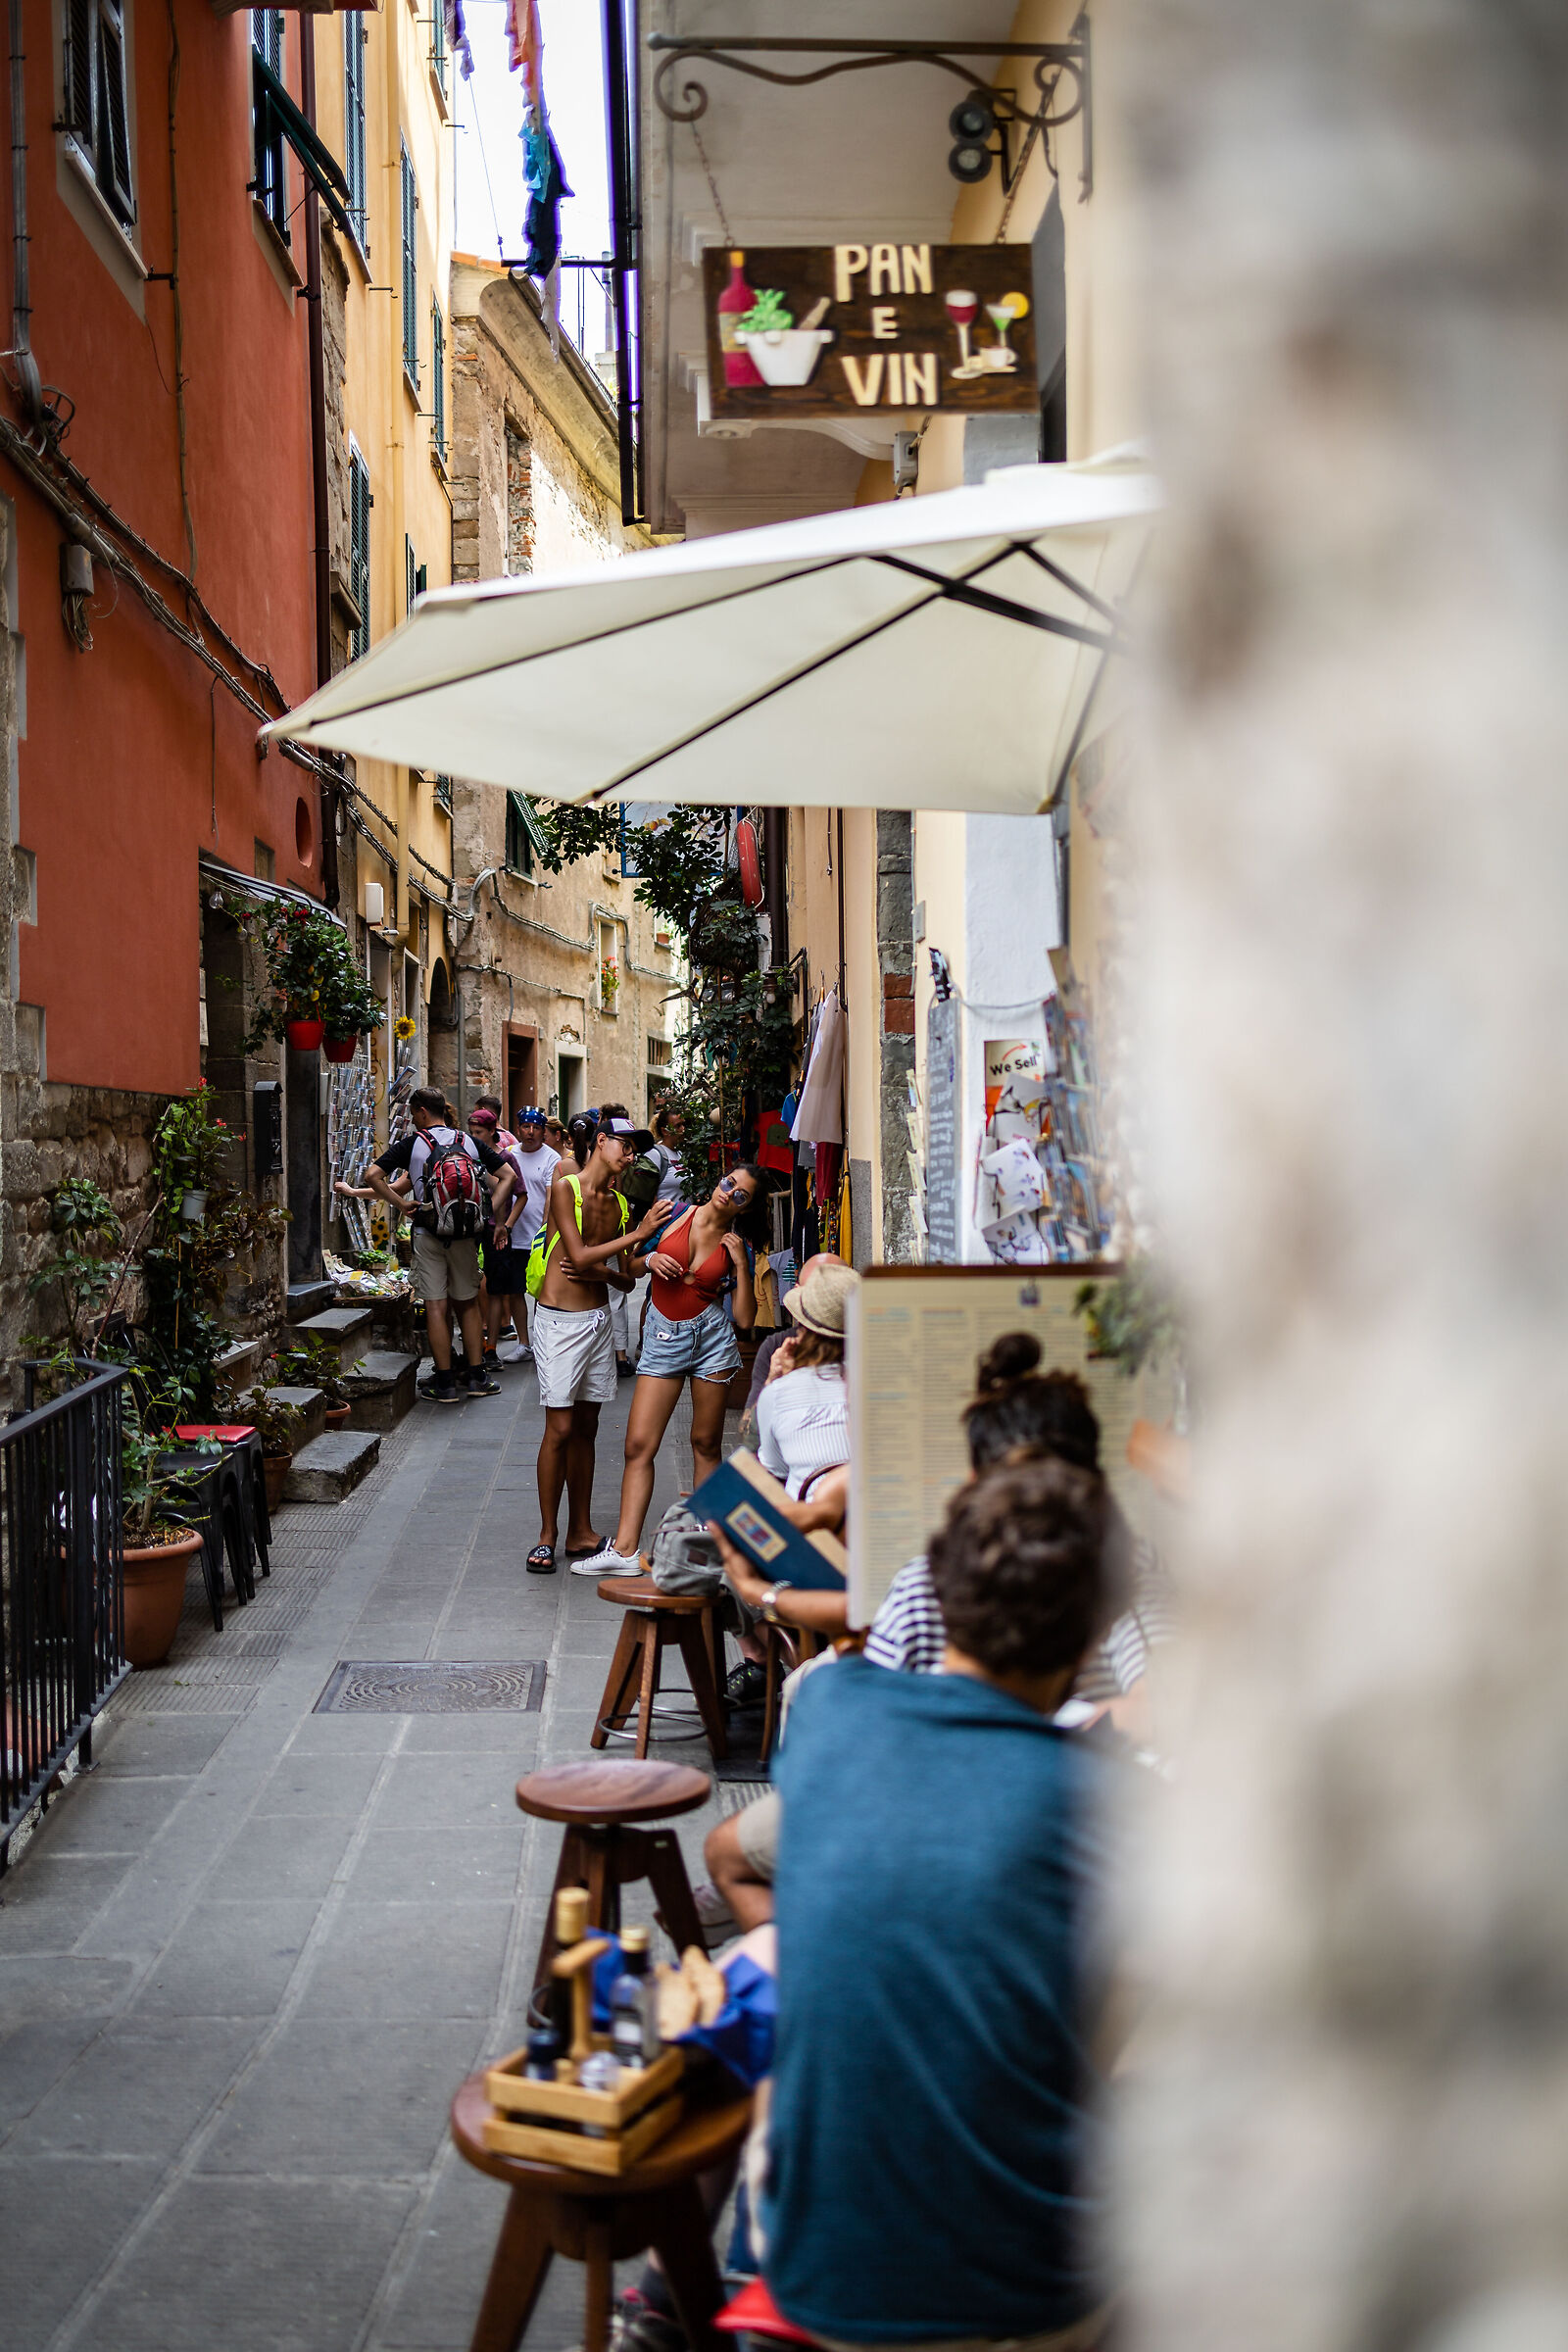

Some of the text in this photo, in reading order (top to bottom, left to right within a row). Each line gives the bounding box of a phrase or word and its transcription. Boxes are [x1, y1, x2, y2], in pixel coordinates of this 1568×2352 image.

[834, 243, 934, 302] PAN
[871, 307, 900, 339] E
[840, 353, 939, 406] VIN
[990, 1055, 1038, 1076] We Sell
